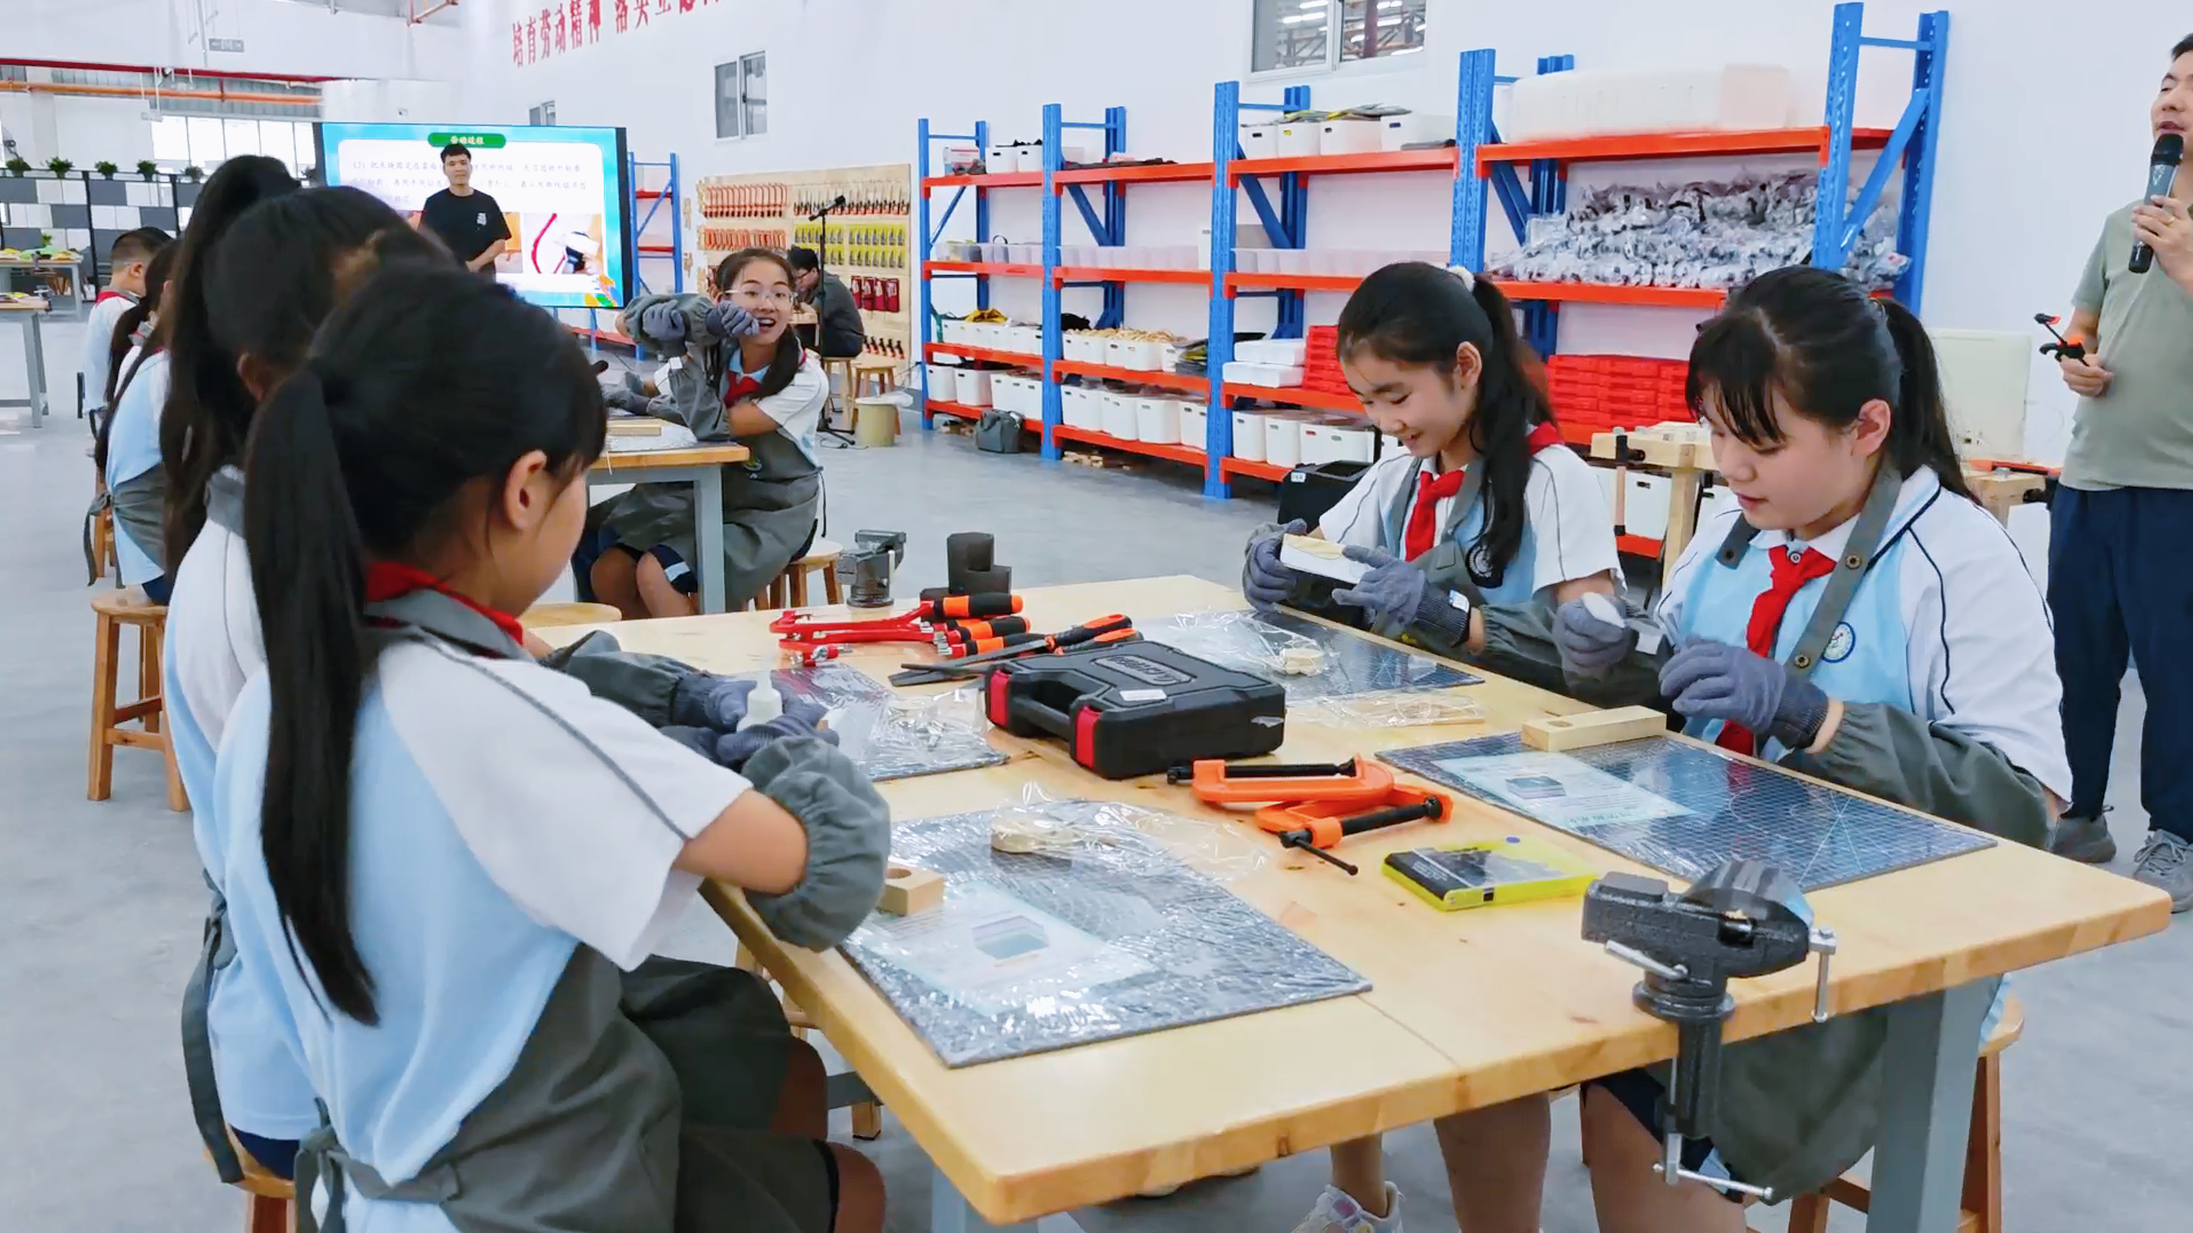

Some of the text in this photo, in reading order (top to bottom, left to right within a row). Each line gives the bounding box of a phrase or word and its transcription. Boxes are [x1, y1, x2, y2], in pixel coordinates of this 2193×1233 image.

[512, 0, 601, 68] 培育劳动精神
